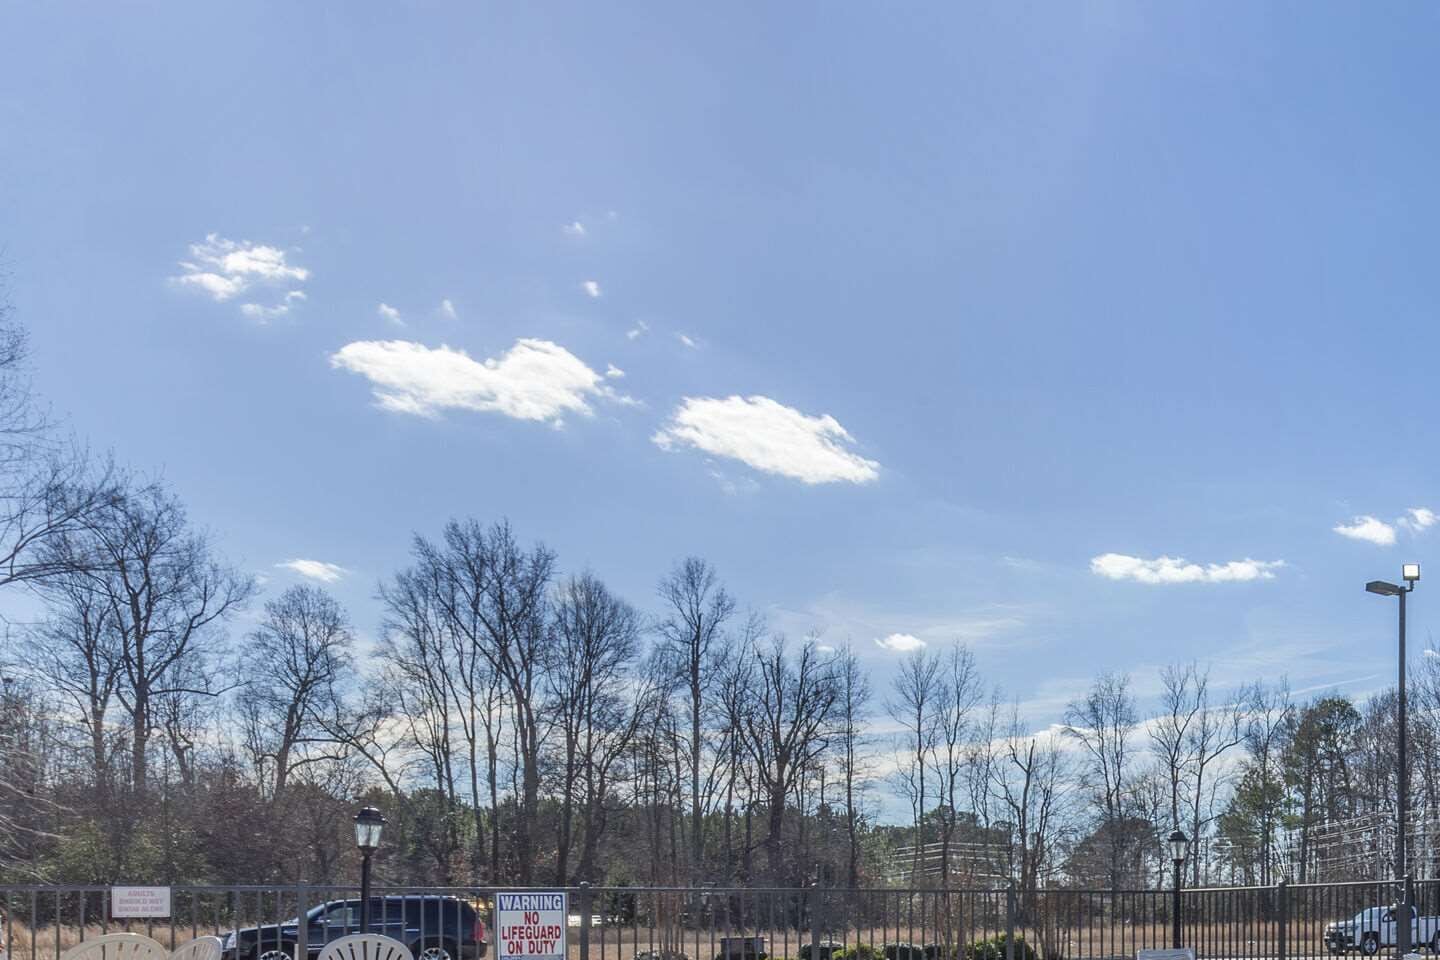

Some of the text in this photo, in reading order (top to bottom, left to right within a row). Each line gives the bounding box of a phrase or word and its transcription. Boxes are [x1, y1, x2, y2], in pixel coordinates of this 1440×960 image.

[501, 896, 561, 910] WARNING
[524, 912, 540, 925] NO
[502, 926, 561, 940] LIFEGUARD
[508, 940, 556, 954] ON DUTY
